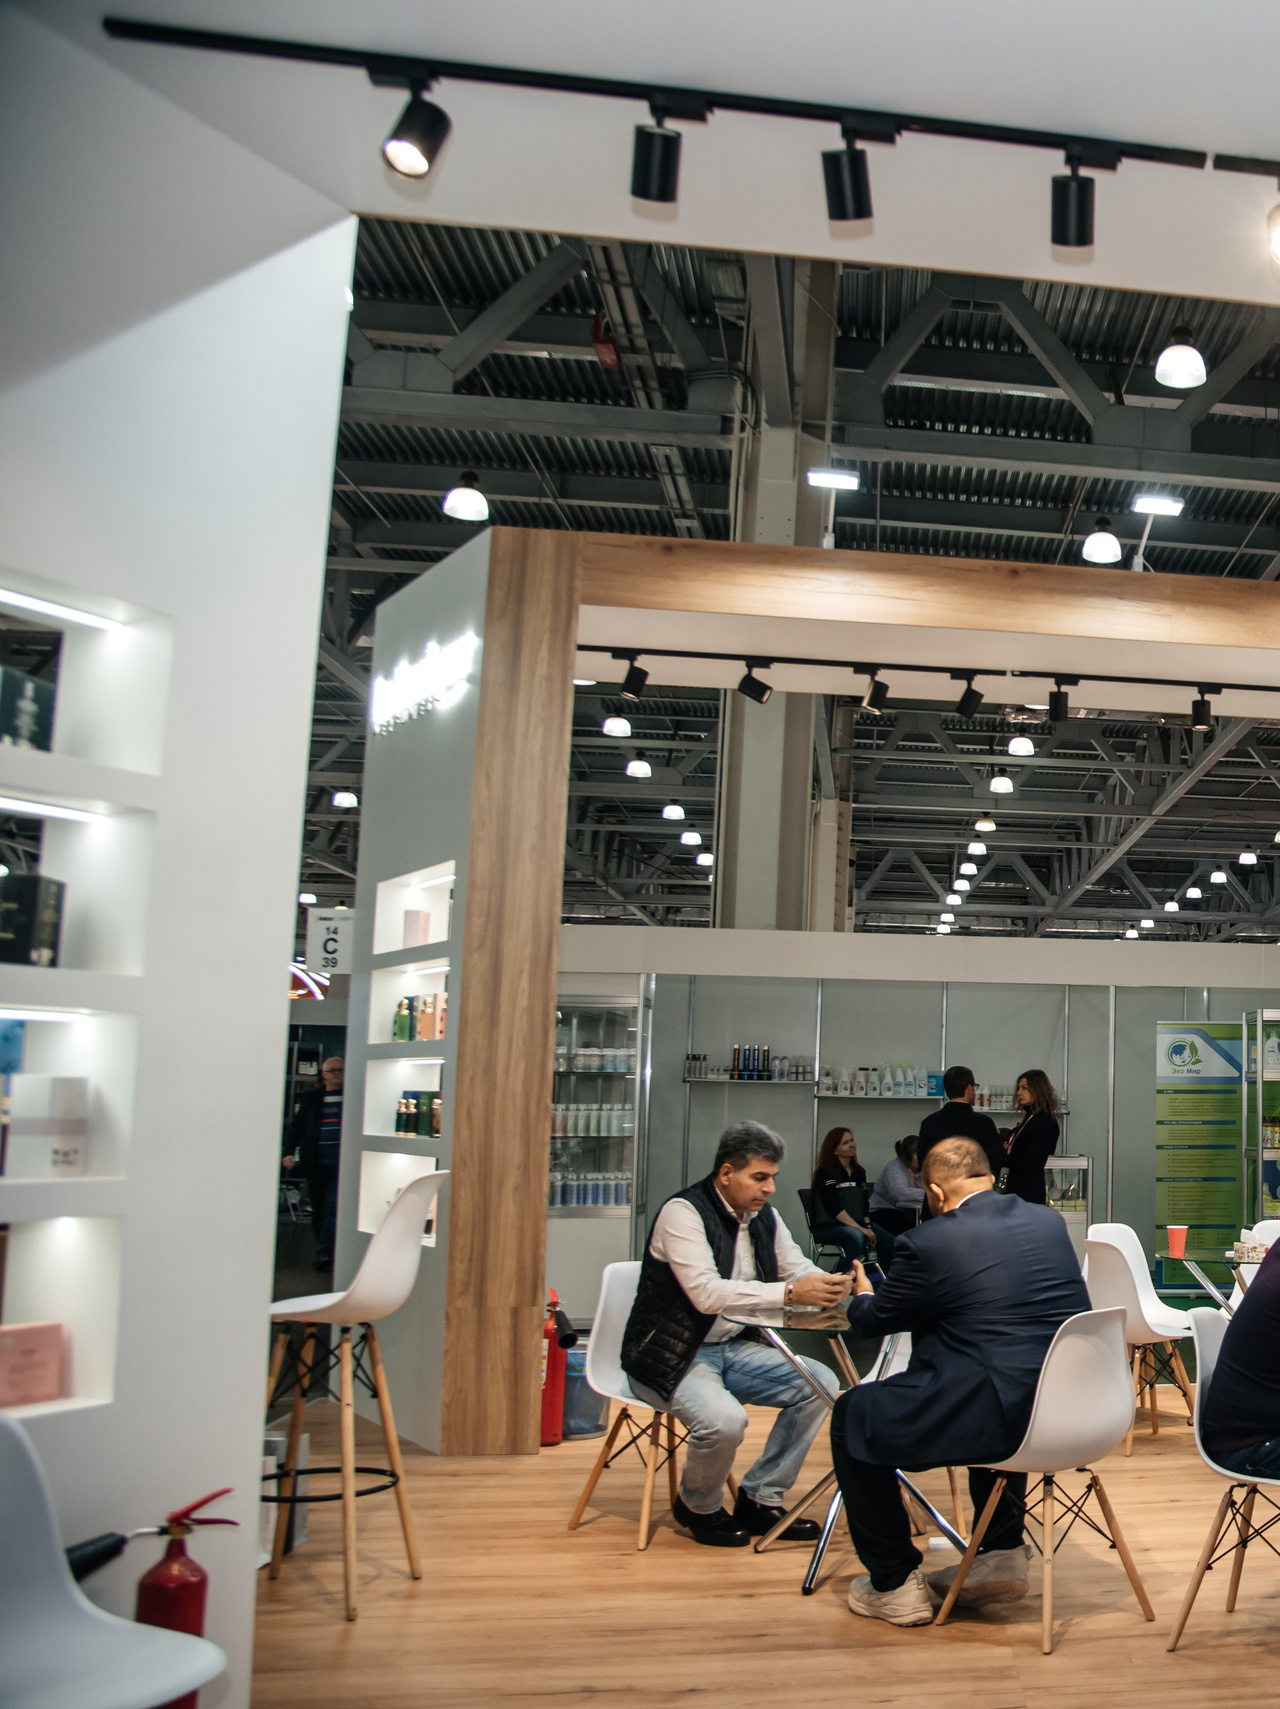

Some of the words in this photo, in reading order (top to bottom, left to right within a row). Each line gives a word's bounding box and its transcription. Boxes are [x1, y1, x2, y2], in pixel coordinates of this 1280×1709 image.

[325, 926, 339, 935] 14
[323, 937, 339, 955] C
[322, 957, 338, 968] 39
